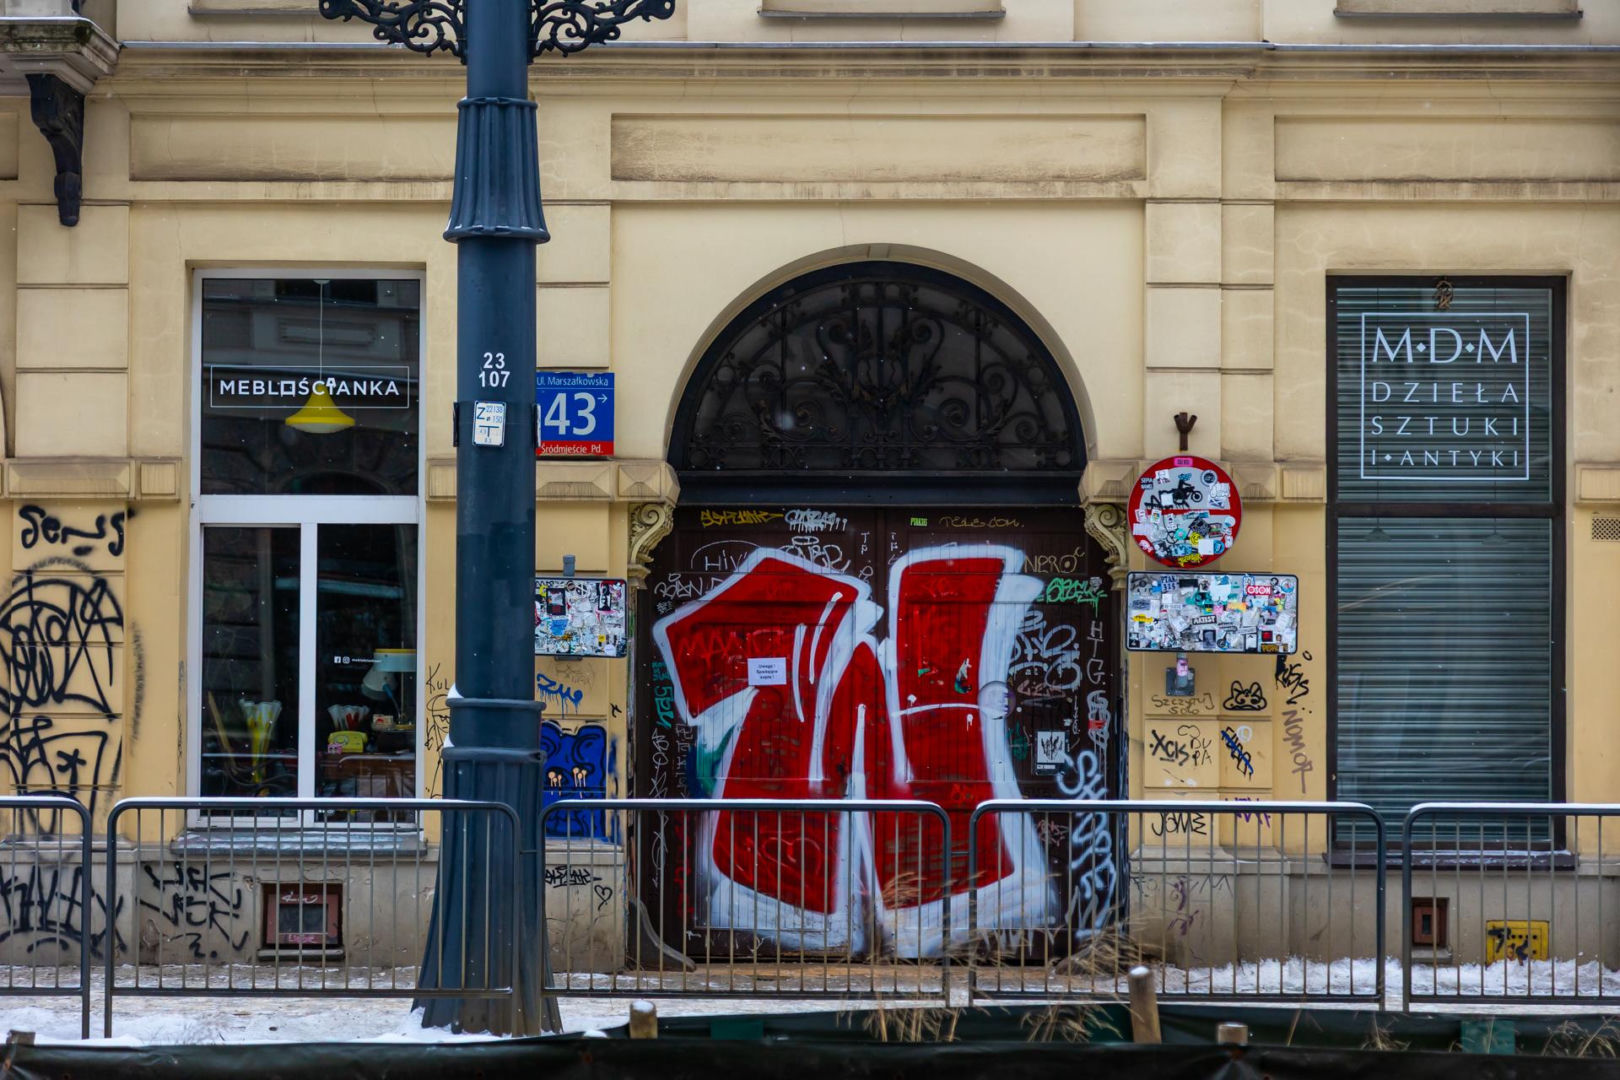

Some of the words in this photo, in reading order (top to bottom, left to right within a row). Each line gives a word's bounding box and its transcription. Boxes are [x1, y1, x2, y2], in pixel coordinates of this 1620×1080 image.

[483, 352, 505, 369] 23
[478, 371, 510, 388] 107
[547, 376, 609, 386] Marszałkowska
[1372, 382, 1519, 403] DZIEŁA
[1371, 416, 1518, 436] SZTUKI
[541, 443, 587, 454] Śródmieście
